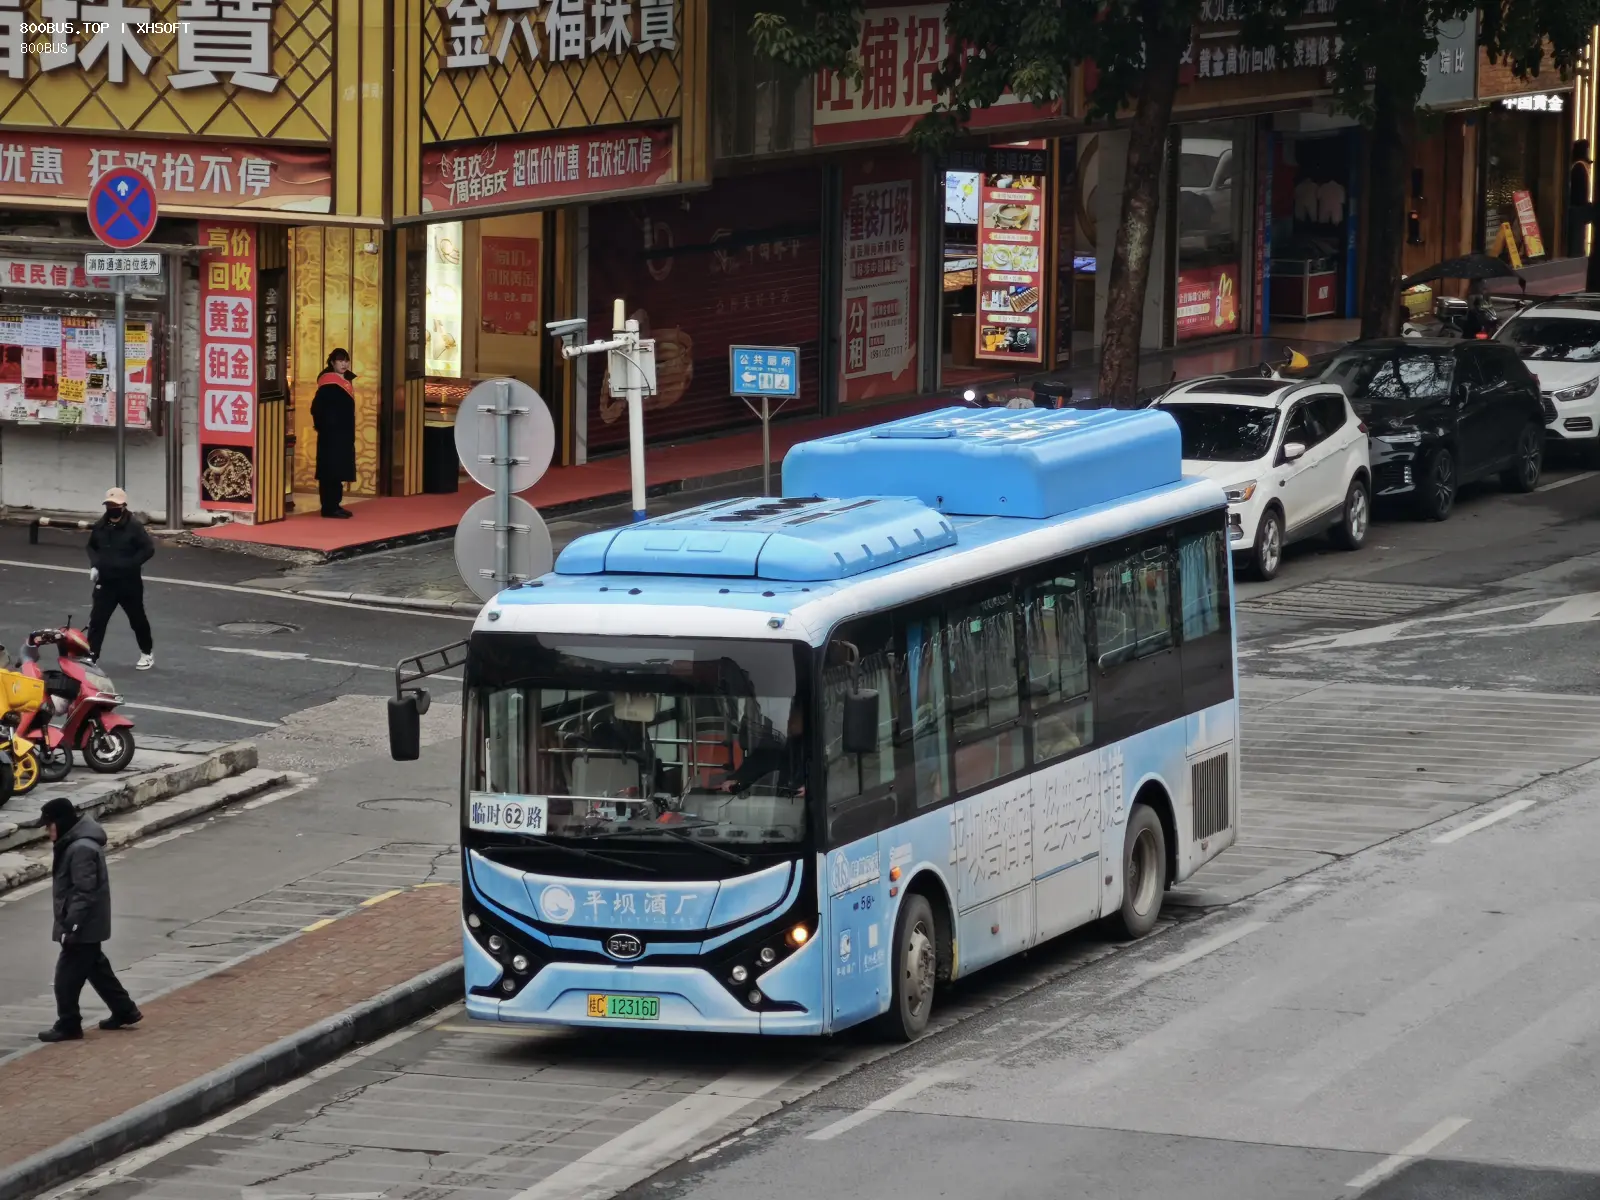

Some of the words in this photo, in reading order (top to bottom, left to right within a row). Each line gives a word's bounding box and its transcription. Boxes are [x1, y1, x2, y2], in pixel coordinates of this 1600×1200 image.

[0, 0, 281, 93] 珠寶
[816, 14, 978, 112] 铺招
[1502, 95, 1564, 112] 中国黄金
[88, 148, 272, 197] 狂欢抢不停
[452, 153, 483, 181] 狂欢
[513, 144, 581, 188] 超低价优惠
[587, 137, 653, 179] 狂欢抢不停
[448, 168, 510, 206] 7周年店庆
[849, 187, 909, 241] 重装升级
[207, 227, 252, 257] 高价
[88, 257, 157, 272] 消防通道泊位线外
[207, 260, 252, 292] 回收
[208, 300, 250, 334] 黄金
[848, 302, 865, 370] 分租
[208, 346, 250, 381] 铂金
[740, 354, 791, 368] 公共厕所
[210, 394, 250, 426] K金
[472, 801, 542, 829] 临时62路
[583, 890, 698, 922] 平坝酒厂
[611, 940, 637, 952] BYD
